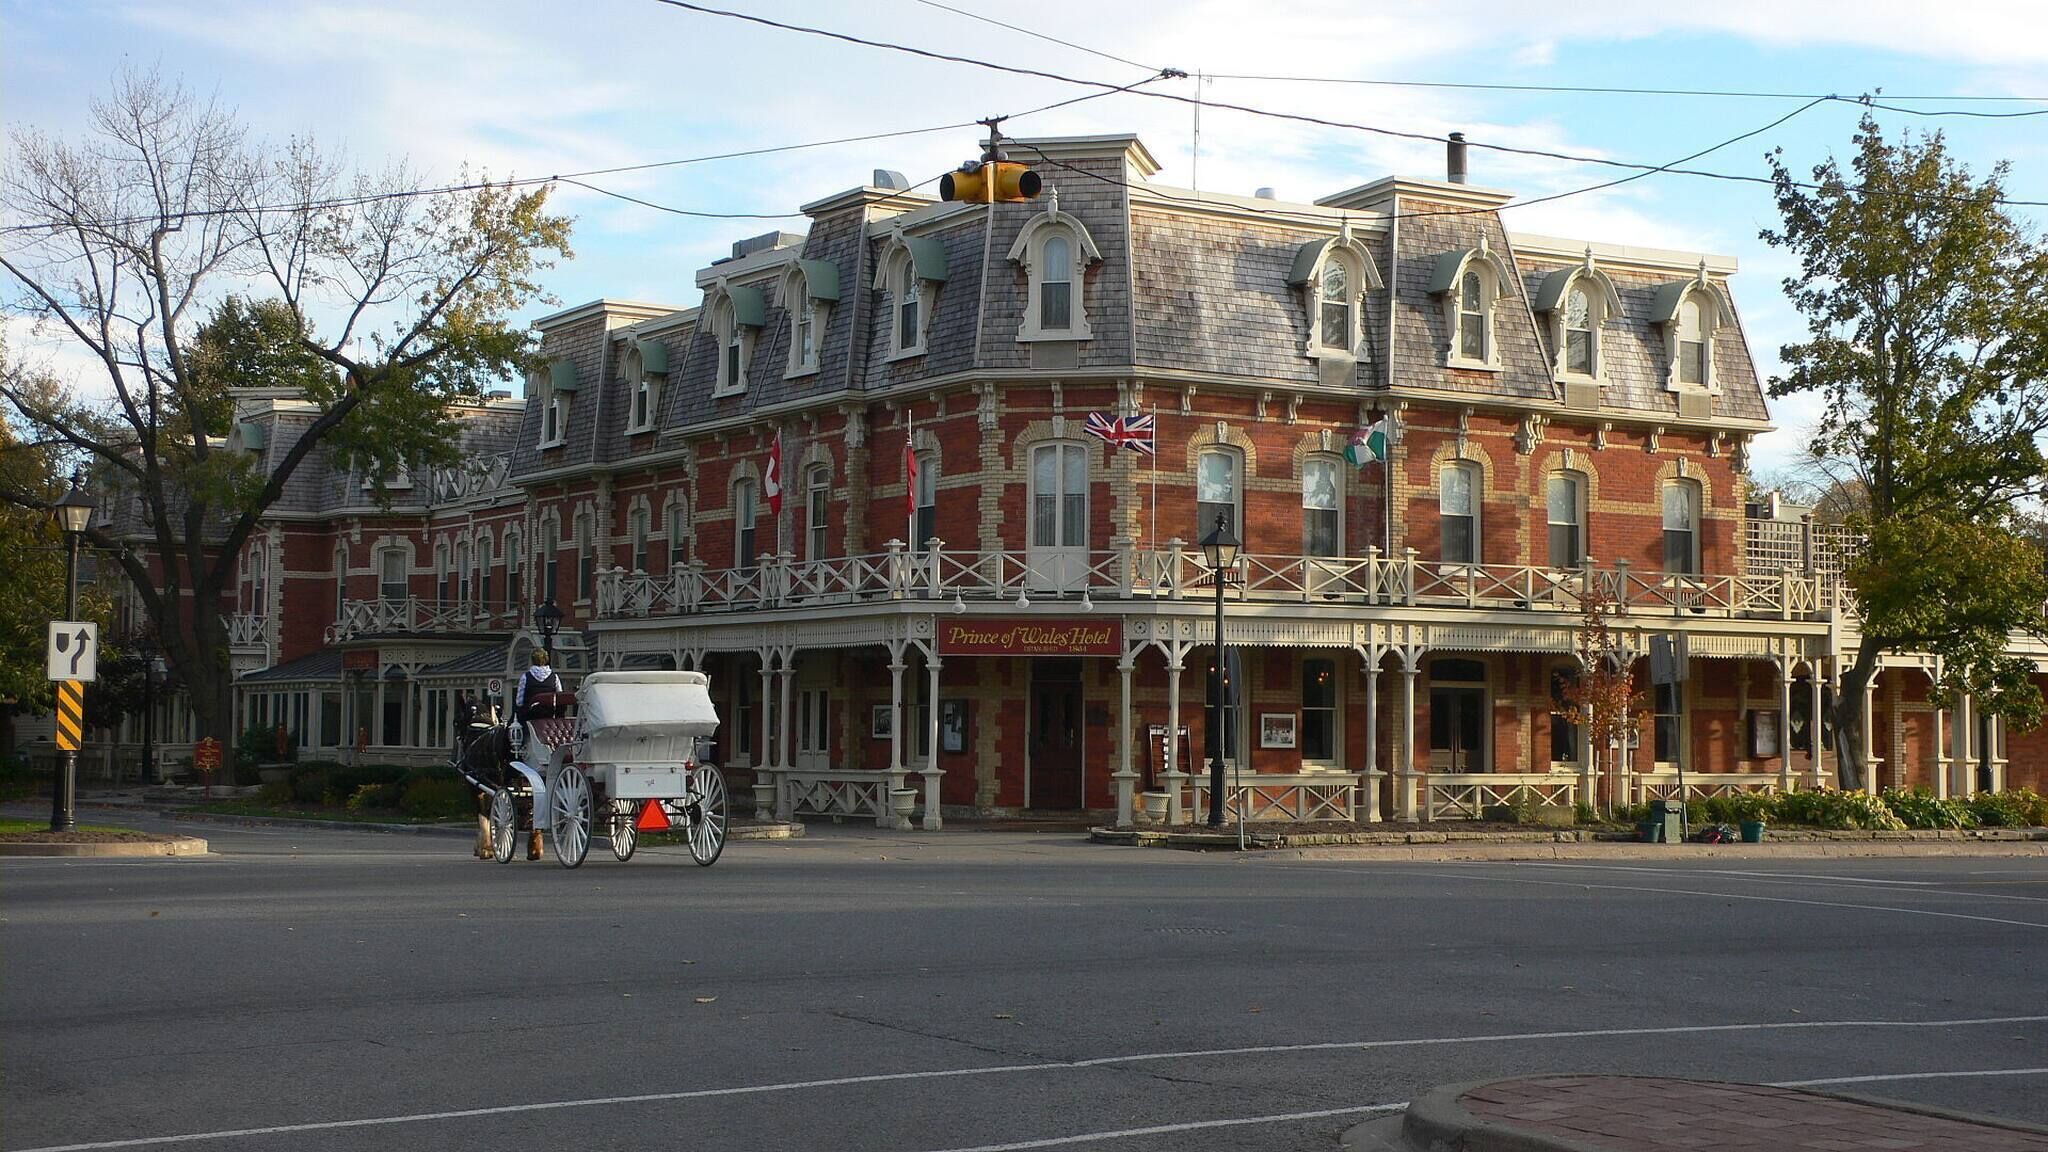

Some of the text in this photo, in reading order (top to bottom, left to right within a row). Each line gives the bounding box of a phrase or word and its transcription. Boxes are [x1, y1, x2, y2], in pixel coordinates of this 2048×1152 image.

[948, 627, 999, 644] Prince
[1001, 626, 1020, 649] of
[1068, 627, 1112, 645] Hotel
